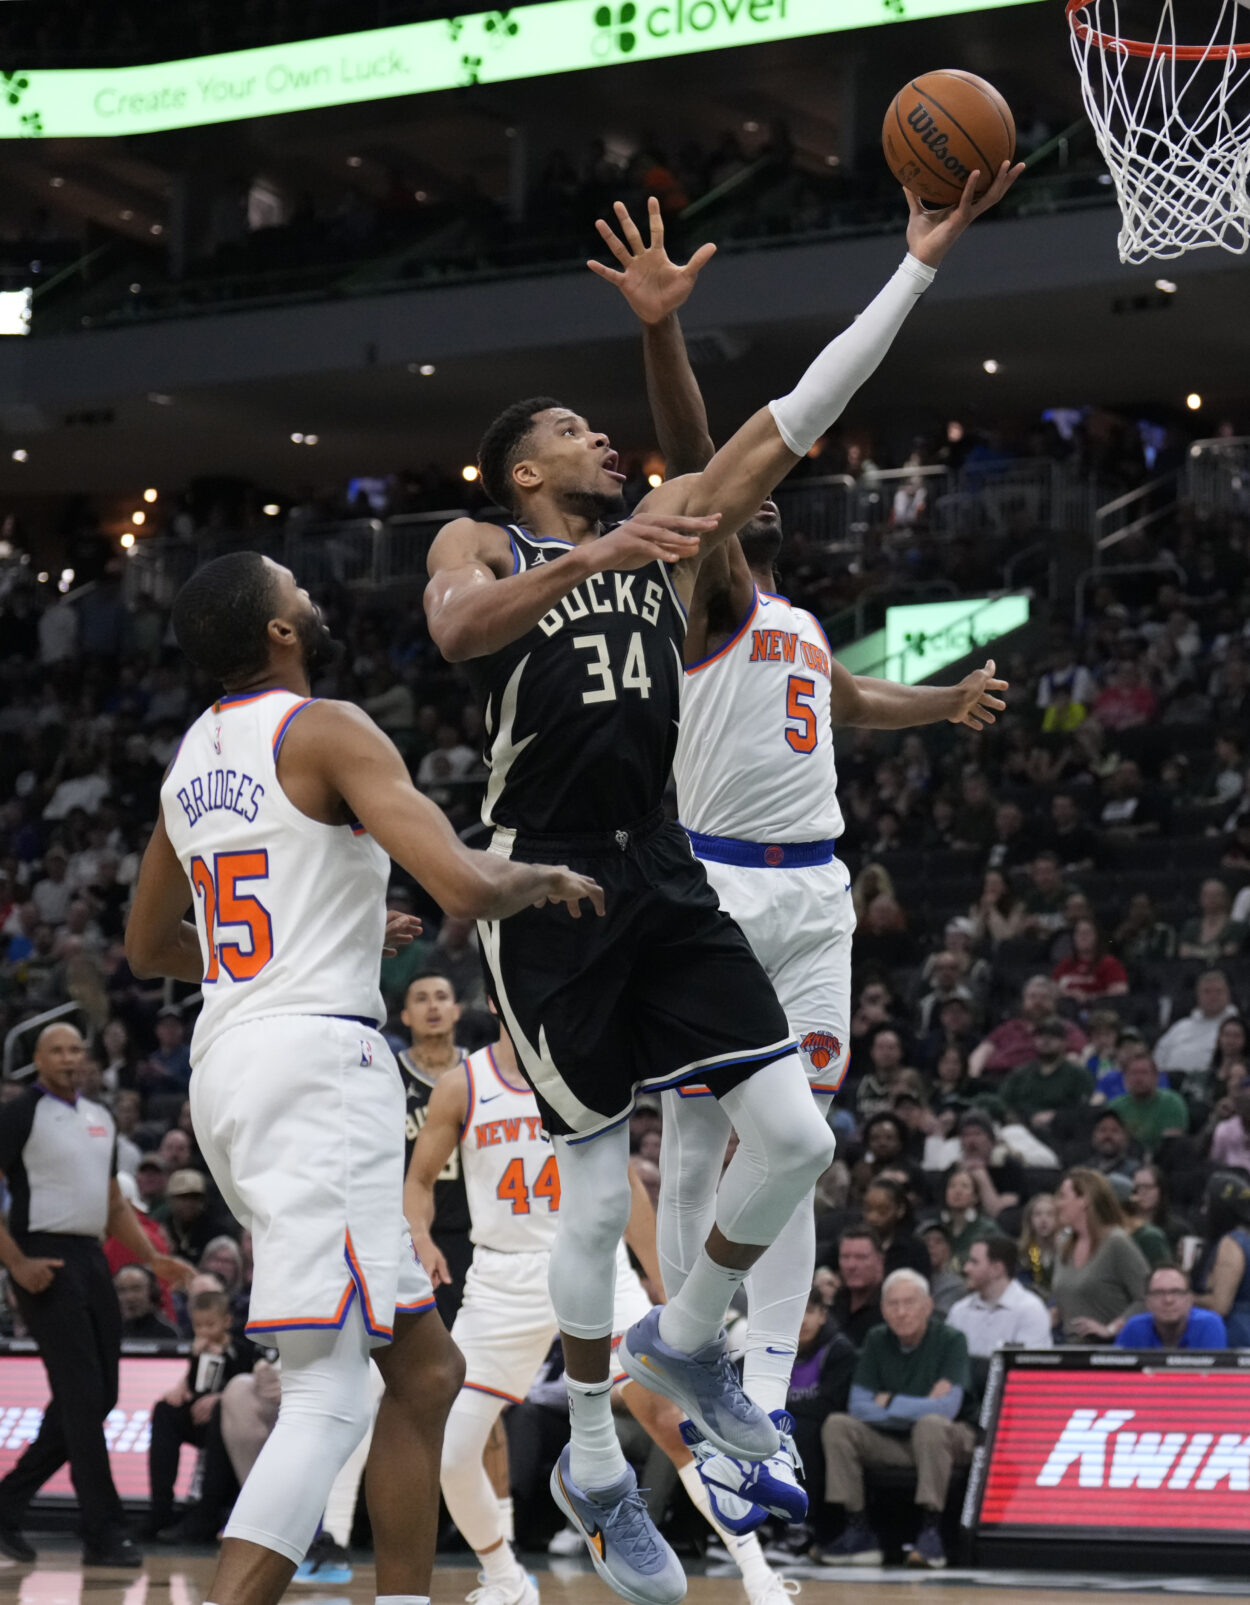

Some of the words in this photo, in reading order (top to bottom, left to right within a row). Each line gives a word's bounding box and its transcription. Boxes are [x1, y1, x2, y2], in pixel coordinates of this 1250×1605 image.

[93, 87, 188, 118] Create
[197, 76, 256, 103] Your
[264, 63, 330, 94] Own
[340, 49, 411, 84] Luck.
[907, 102, 971, 182] Wilson
[572, 631, 652, 705] 34
[749, 629, 799, 664] NEW
[784, 674, 819, 755] 5
[177, 769, 265, 828] BRIDGES
[190, 848, 274, 984] 25
[474, 1117, 522, 1150] NEW
[497, 1155, 562, 1215] 44
